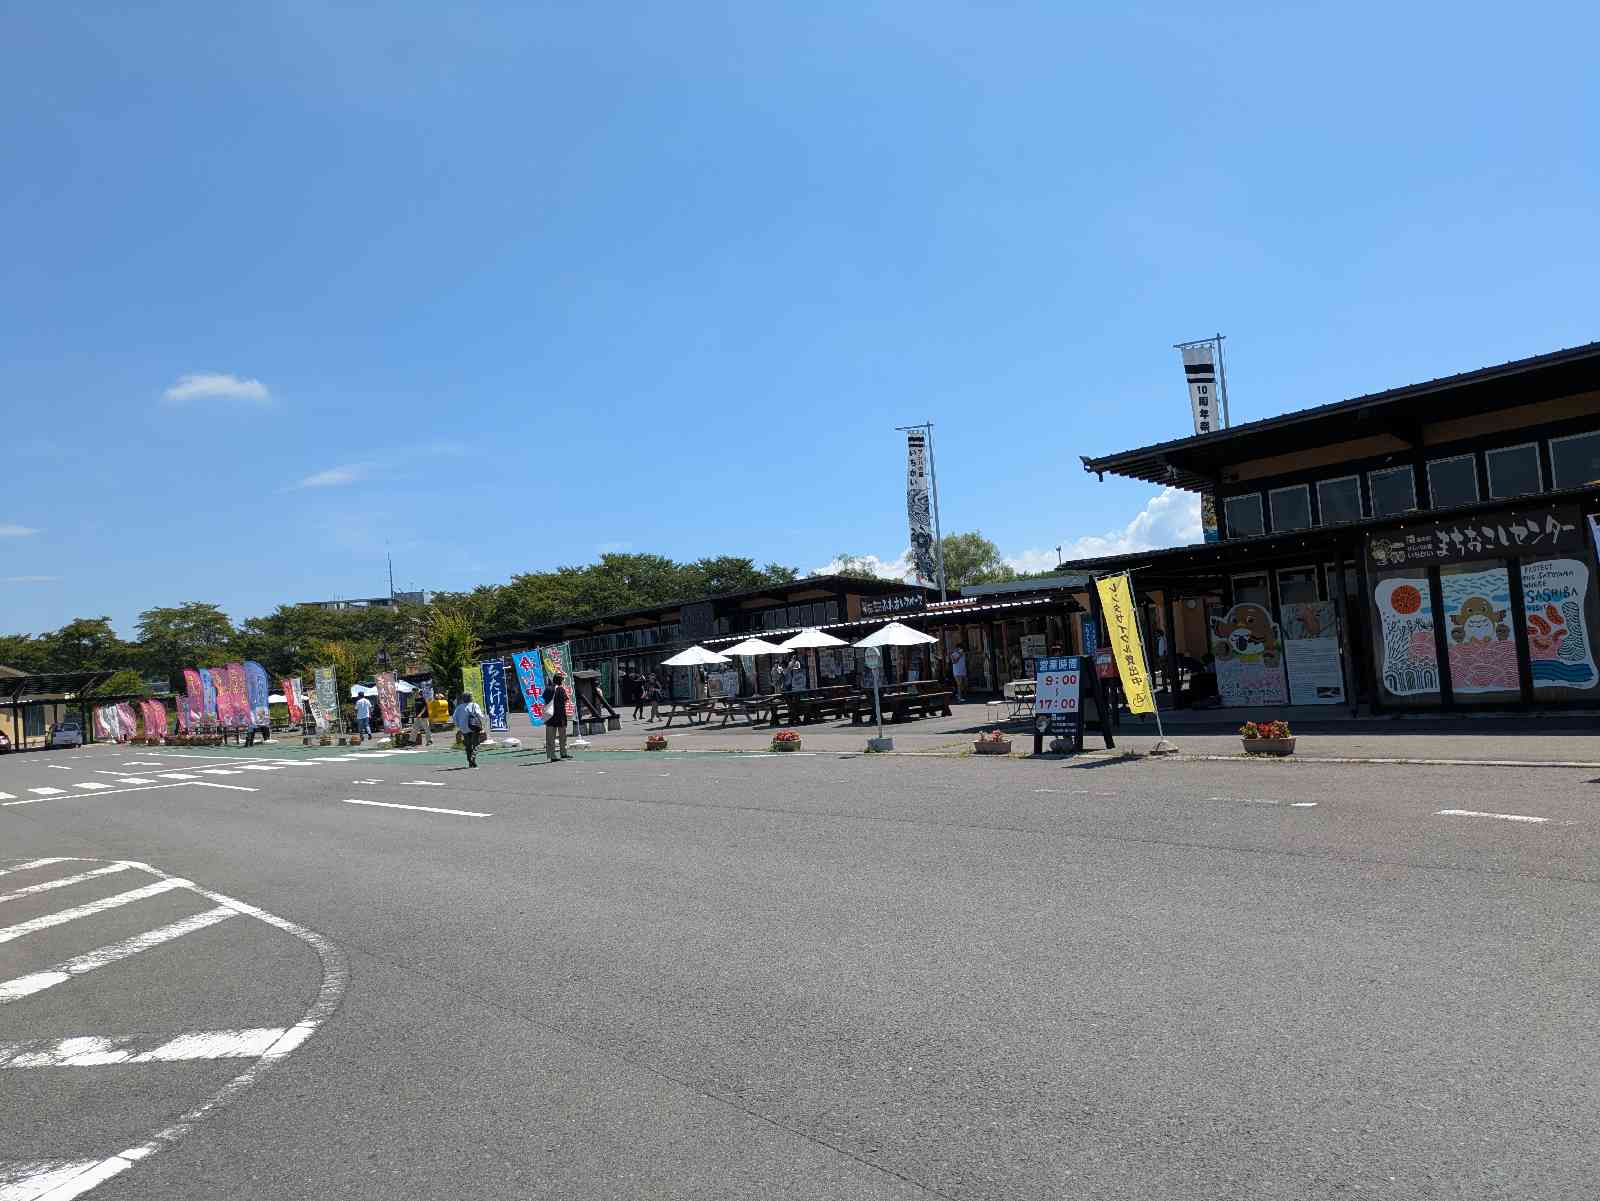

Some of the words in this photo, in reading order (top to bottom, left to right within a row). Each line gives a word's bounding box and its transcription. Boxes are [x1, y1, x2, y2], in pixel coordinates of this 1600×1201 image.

[909, 449, 918, 486] いちかい
[1435, 513, 1576, 557] まちおこしセンター
[1526, 585, 1579, 604] SASHIBA
[1039, 658, 1078, 672] 営業時間
[1045, 674, 1077, 686] 9:00
[1039, 698, 1076, 709] 17:00
